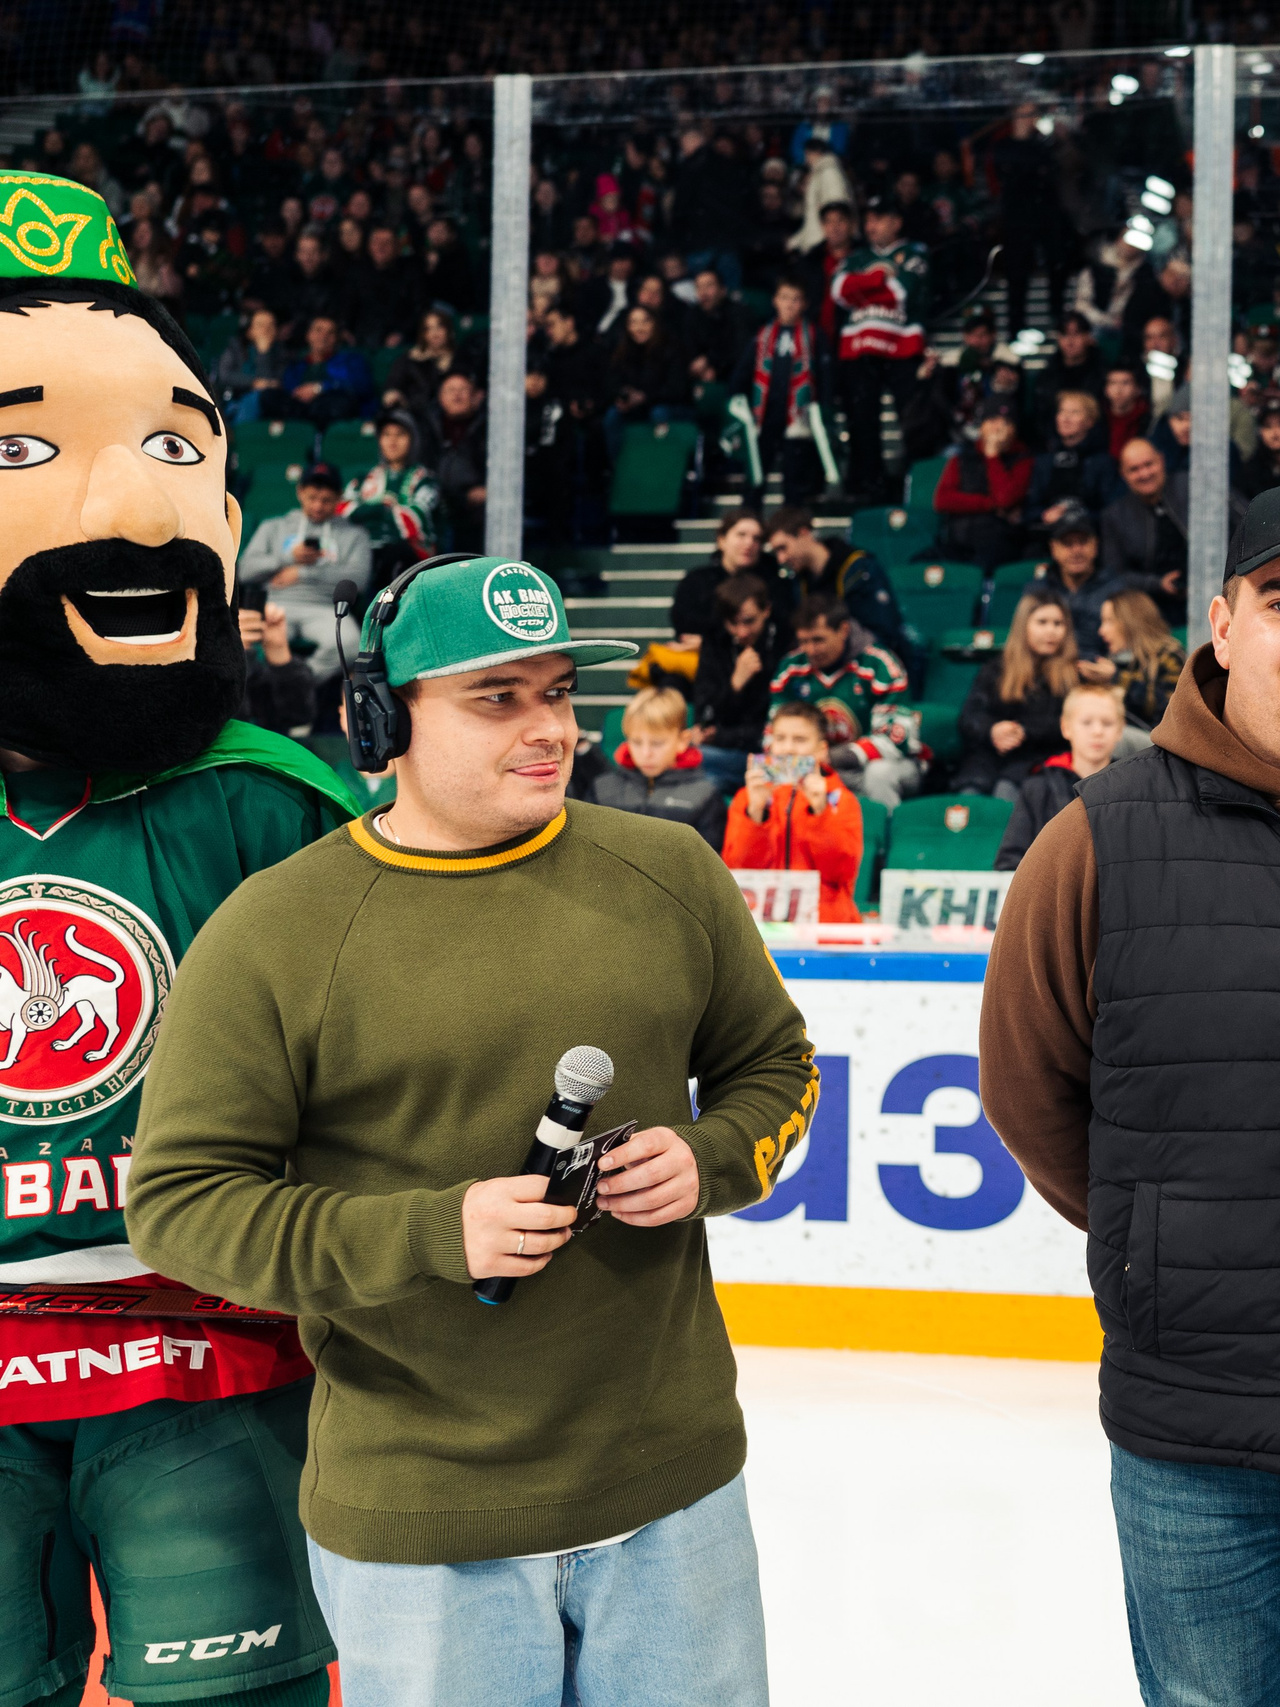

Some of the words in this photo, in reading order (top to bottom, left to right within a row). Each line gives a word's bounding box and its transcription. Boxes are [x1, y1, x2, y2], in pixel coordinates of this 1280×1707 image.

[493, 590, 514, 605] AK
[518, 589, 549, 604] BARS
[498, 604, 549, 619] HOCKEY
[0, 1335, 213, 1390] ATNEFT
[144, 1624, 282, 1664] CCM
